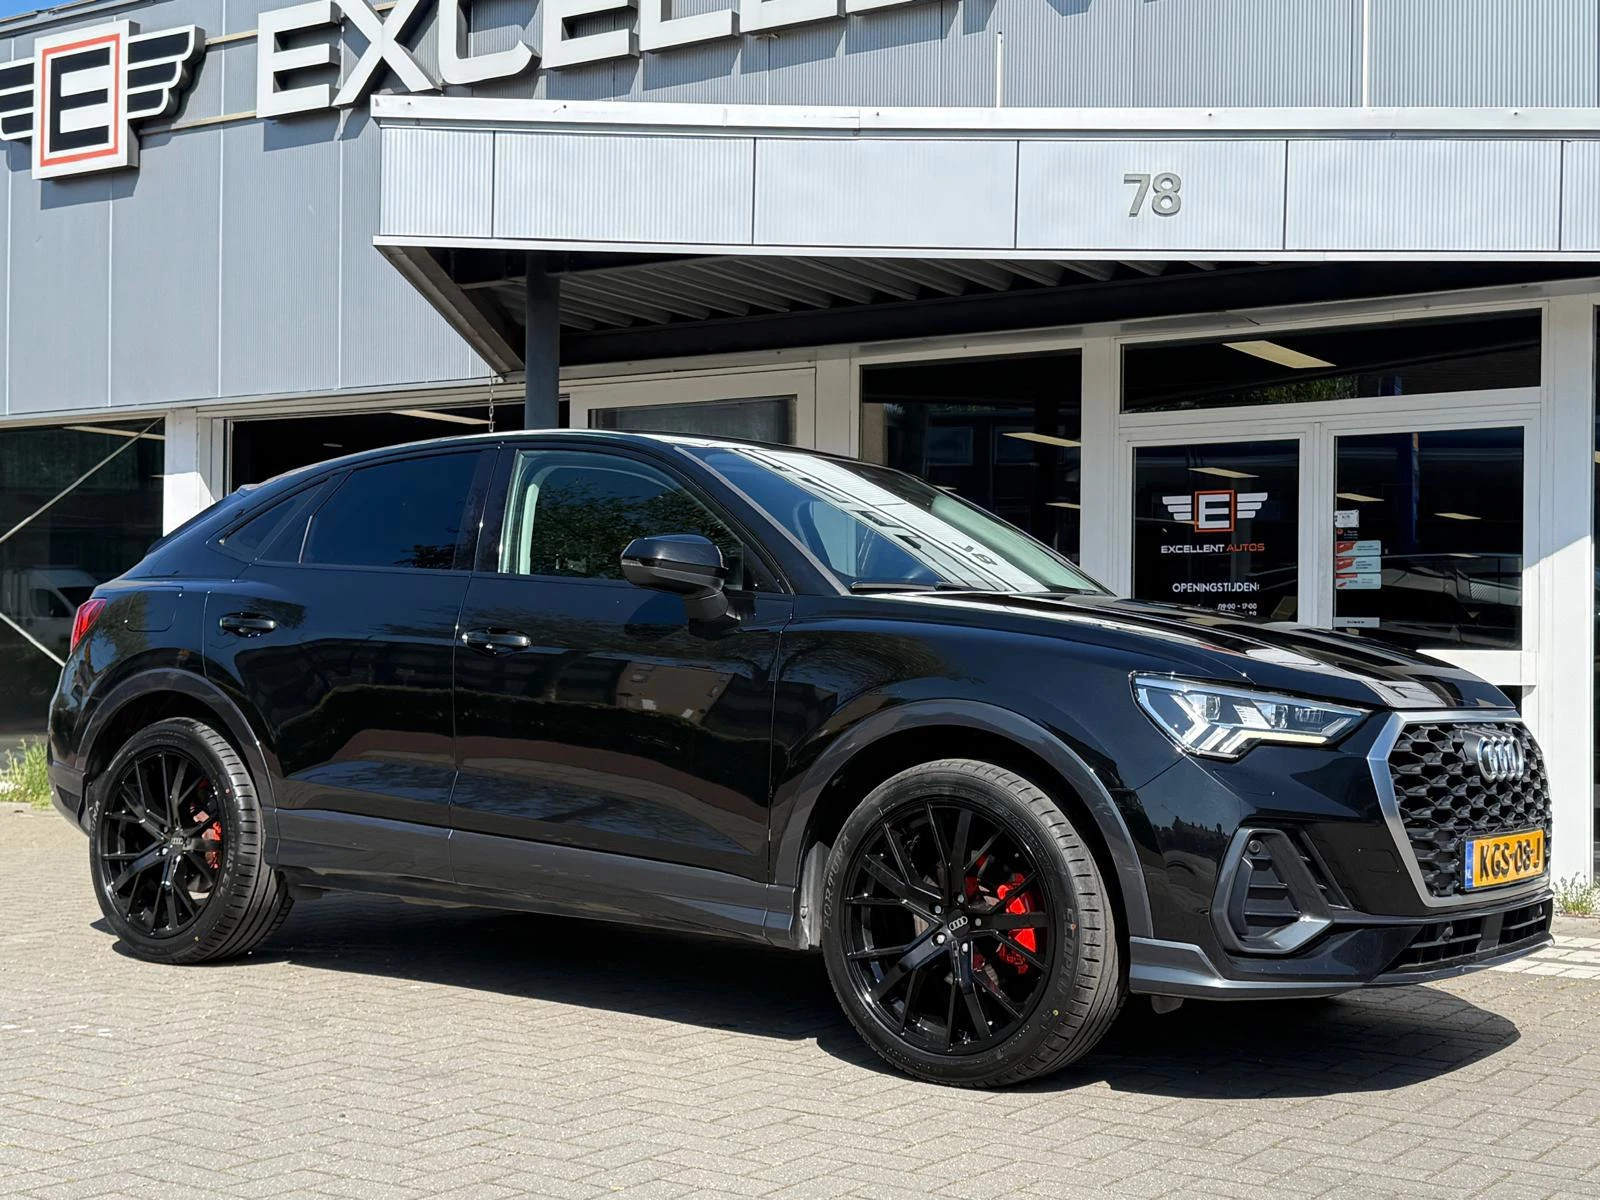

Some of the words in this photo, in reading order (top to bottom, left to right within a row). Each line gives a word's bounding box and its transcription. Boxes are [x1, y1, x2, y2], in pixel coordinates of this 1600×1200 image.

[1123, 172, 1181, 217] 78
[1160, 544, 1225, 554] EXCELLENT
[1226, 543, 1265, 552] AUTOS
[1480, 838, 1541, 881] KGS-08-J
